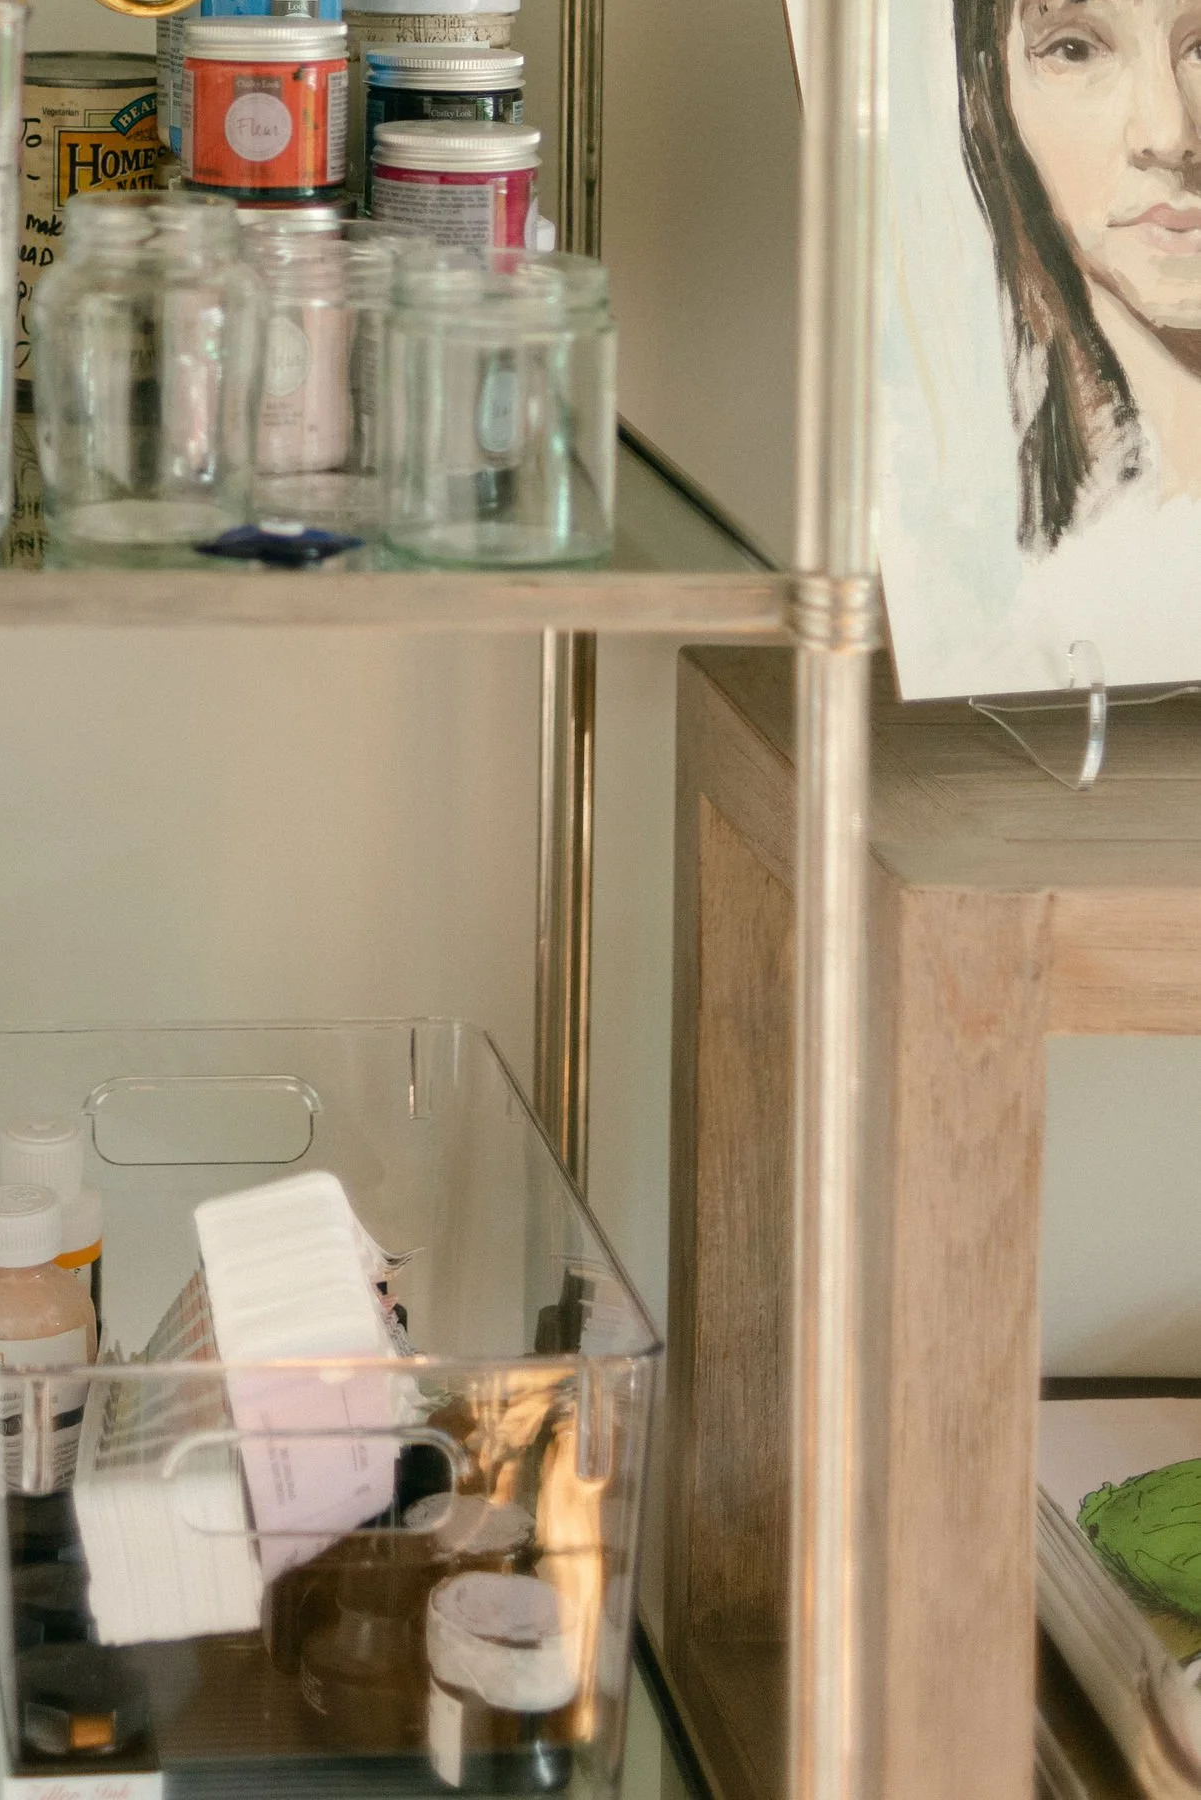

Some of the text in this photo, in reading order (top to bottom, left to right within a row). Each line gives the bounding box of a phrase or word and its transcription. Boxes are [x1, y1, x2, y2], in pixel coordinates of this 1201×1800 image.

[288, 1, 307, 11] Look
[42, 106, 79, 117] Vegetarian
[431, 109, 473, 120] Chalky Look
[25, 213, 63, 237] mak
